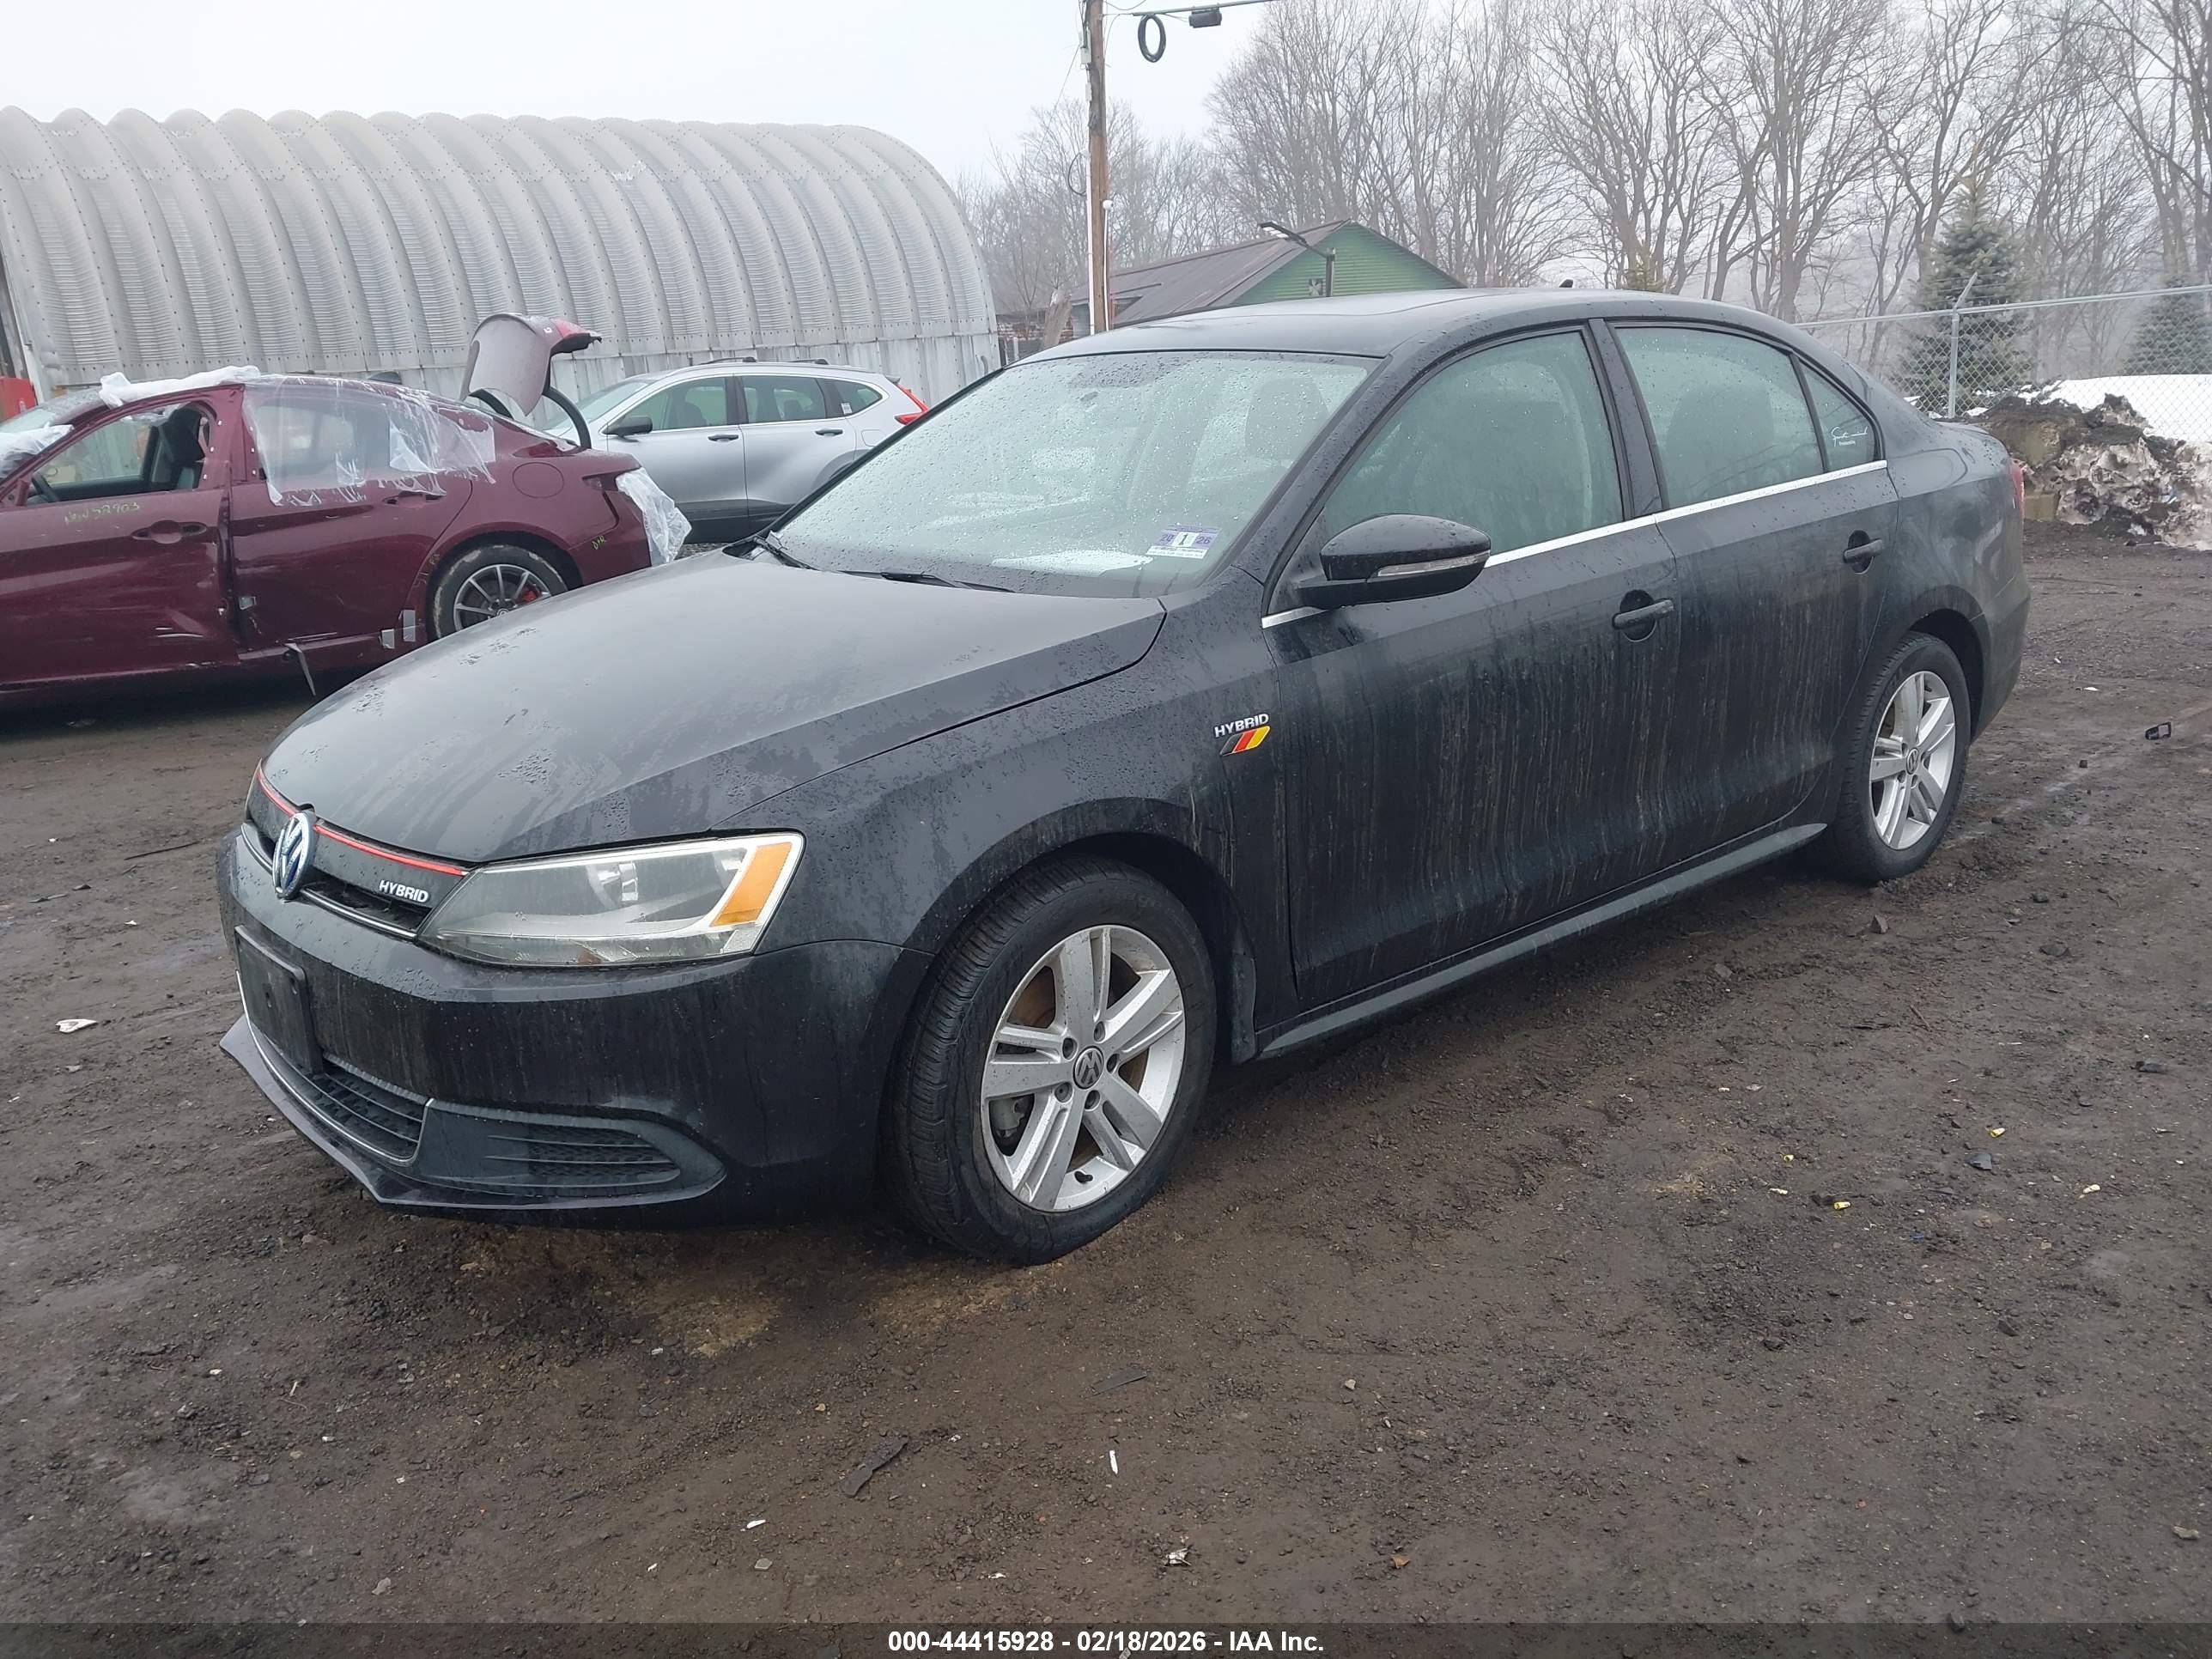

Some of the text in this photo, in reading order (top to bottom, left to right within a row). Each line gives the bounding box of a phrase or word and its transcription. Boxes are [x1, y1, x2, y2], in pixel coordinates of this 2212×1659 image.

[1160, 534, 1175, 543] 20
[1178, 533, 1188, 545] 1
[1214, 714, 1269, 738] HYBRID
[379, 879, 428, 902] HYBRID
